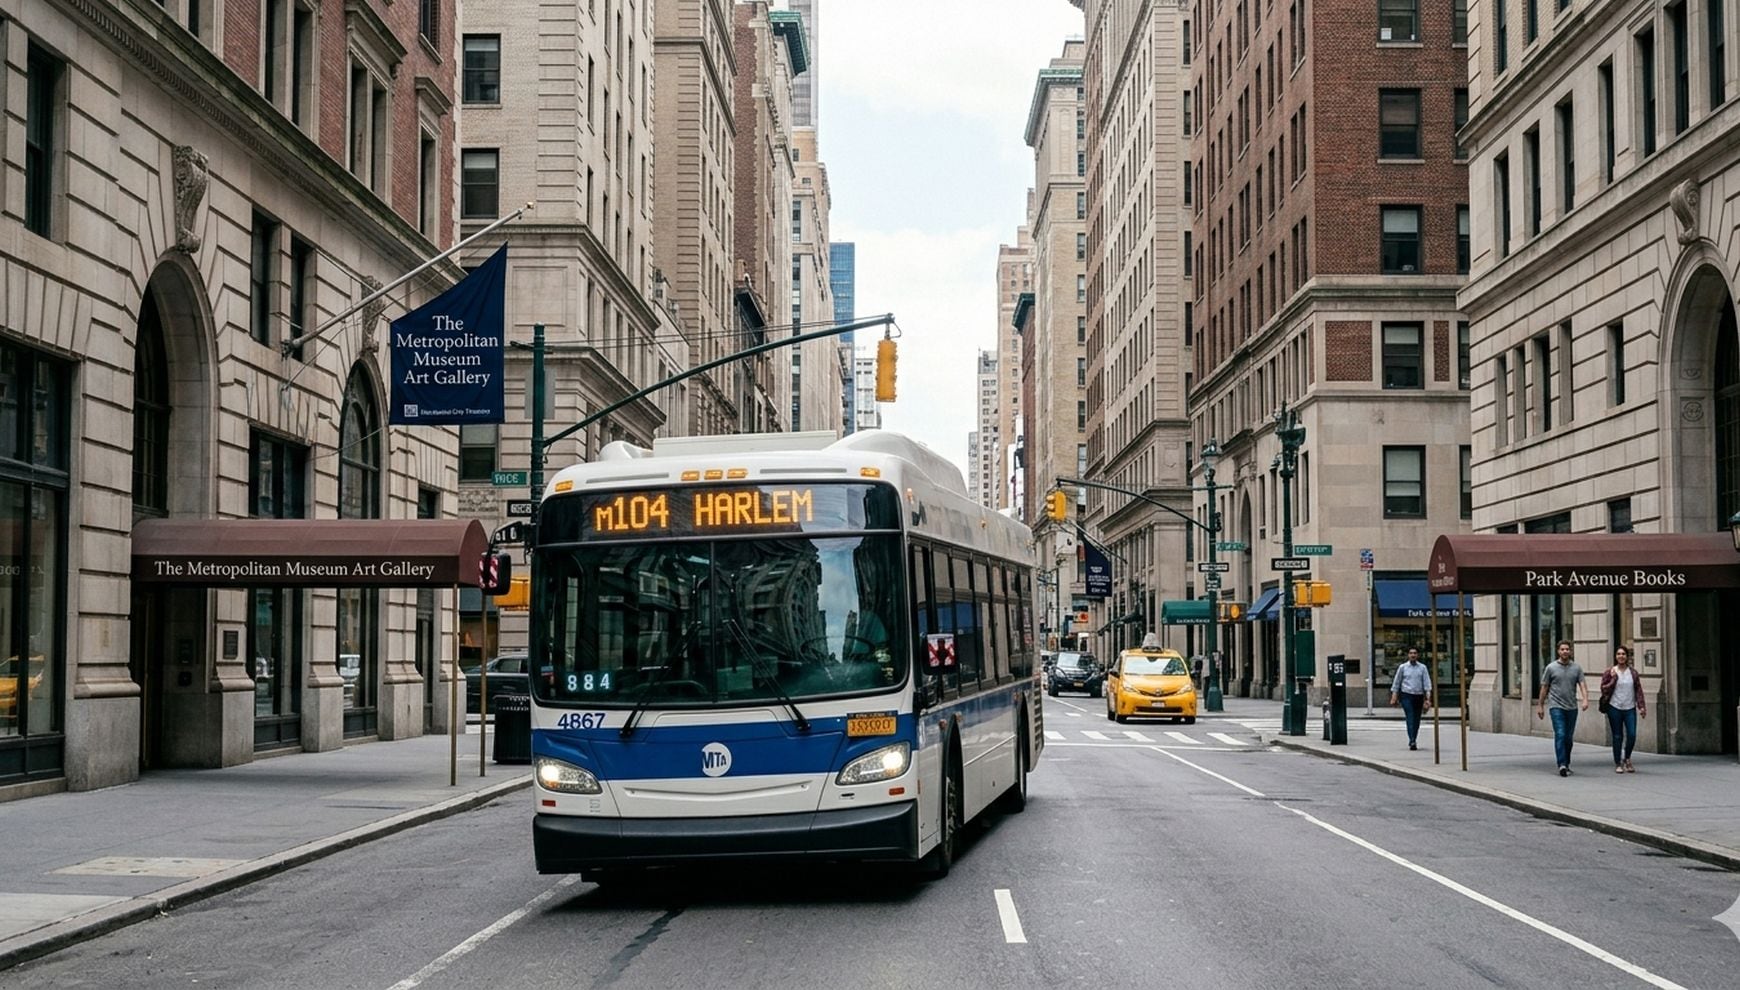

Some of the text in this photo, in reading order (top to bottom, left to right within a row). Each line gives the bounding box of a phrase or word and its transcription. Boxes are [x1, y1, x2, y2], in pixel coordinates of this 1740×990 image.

[432, 315, 464, 331] The
[396, 333, 499, 352] Metropolitan
[413, 351, 481, 366] Museum
[403, 370, 491, 388] Art Gallery
[695, 489, 814, 526] HARLEM
[154, 561, 435, 580] The Metropolitan Museum Art Gallery
[1525, 570, 1686, 586] Park Avenue Books
[557, 712, 606, 729] 4867
